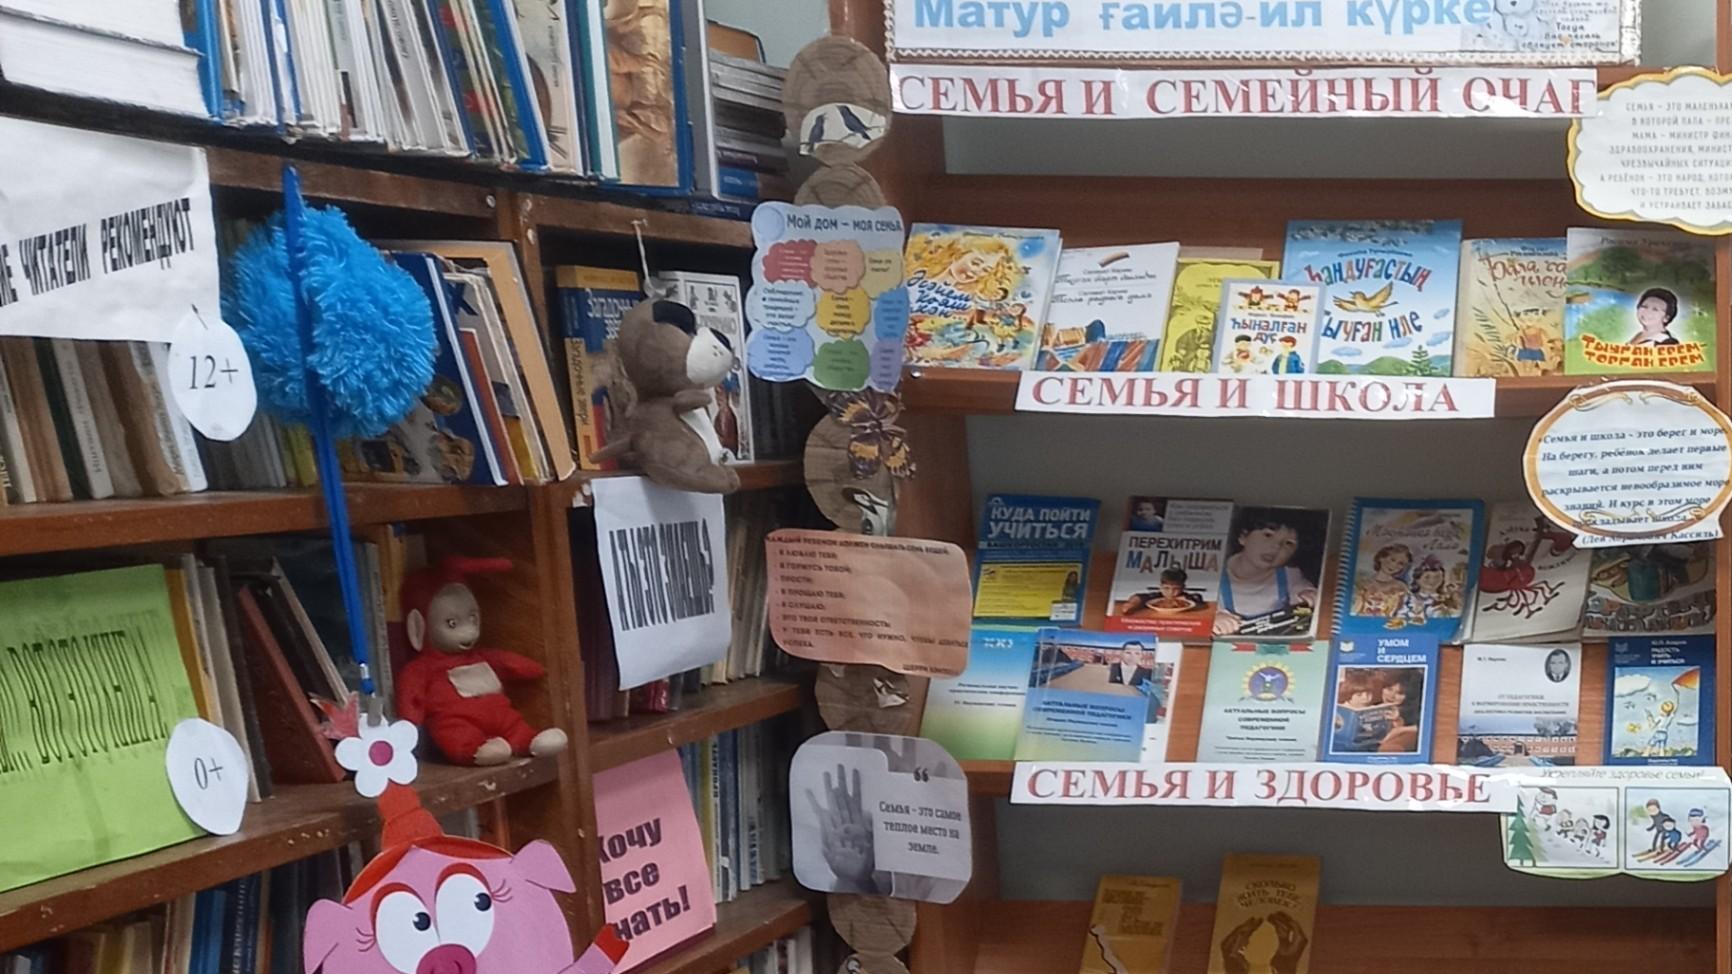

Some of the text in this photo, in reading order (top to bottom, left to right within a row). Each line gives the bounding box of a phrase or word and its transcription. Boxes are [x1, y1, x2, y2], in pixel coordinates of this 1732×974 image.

[899, 67, 1596, 116] СЕМЬЯ И СЕМЕЙНЫЙ ОЧАГ
[787, 213, 812, 229] Мой
[814, 217, 838, 230] дом
[852, 219, 873, 232] моя
[19, 223, 91, 296] ЧИТАТЕЛИ
[100, 197, 195, 275] РЕКОМЕНДУЮТ
[187, 354, 240, 390] 12+
[1032, 376, 1460, 413] СЕМЬЯ И ШКОЛА
[1590, 431, 1625, 442] школа
[1656, 429, 1687, 440] берег
[1611, 466, 1645, 476] потом
[1647, 464, 1678, 475] перед
[990, 506, 1091, 521] КУДА ПОЙТИ
[987, 522, 1089, 540] УЧИТЬСЯ
[1128, 536, 1223, 551] ПЕРЕХИТРИМ
[1126, 550, 1219, 574] МАЛЫША
[1377, 638, 1409, 648] УМОМ
[1376, 654, 1427, 664] СЕРДЦЕМ
[193, 756, 223, 790] 0+
[1026, 768, 1492, 805] СЕМЬЯ И ЗДОРОВЬЕ
[614, 884, 691, 942] нать!
